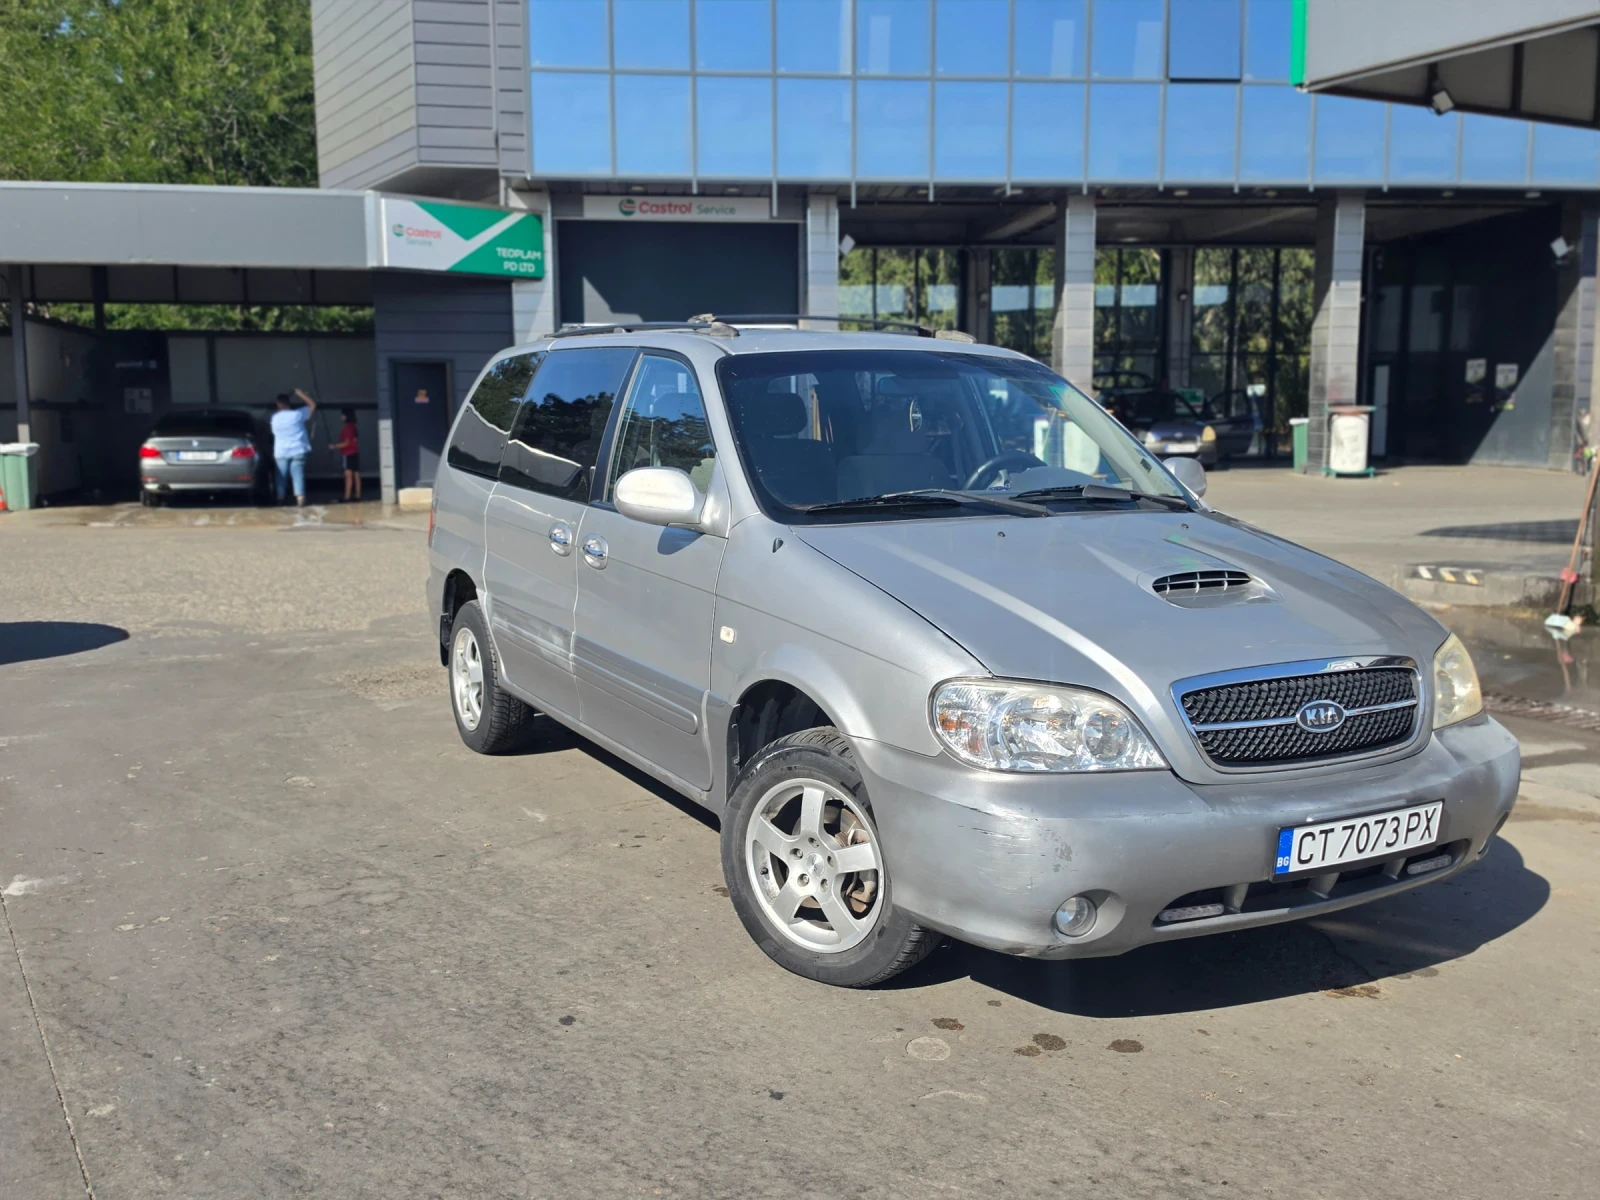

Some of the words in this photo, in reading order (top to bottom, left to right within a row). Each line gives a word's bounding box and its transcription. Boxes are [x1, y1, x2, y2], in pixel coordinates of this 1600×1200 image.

[638, 201, 692, 214] Castrol
[697, 205, 736, 215] Service
[405, 226, 442, 239] Castrol
[497, 247, 541, 260] TEOPLAM
[504, 261, 516, 271] PD
[519, 262, 535, 272] LTD
[1305, 707, 1339, 726] KIA
[1276, 856, 1290, 868] BG
